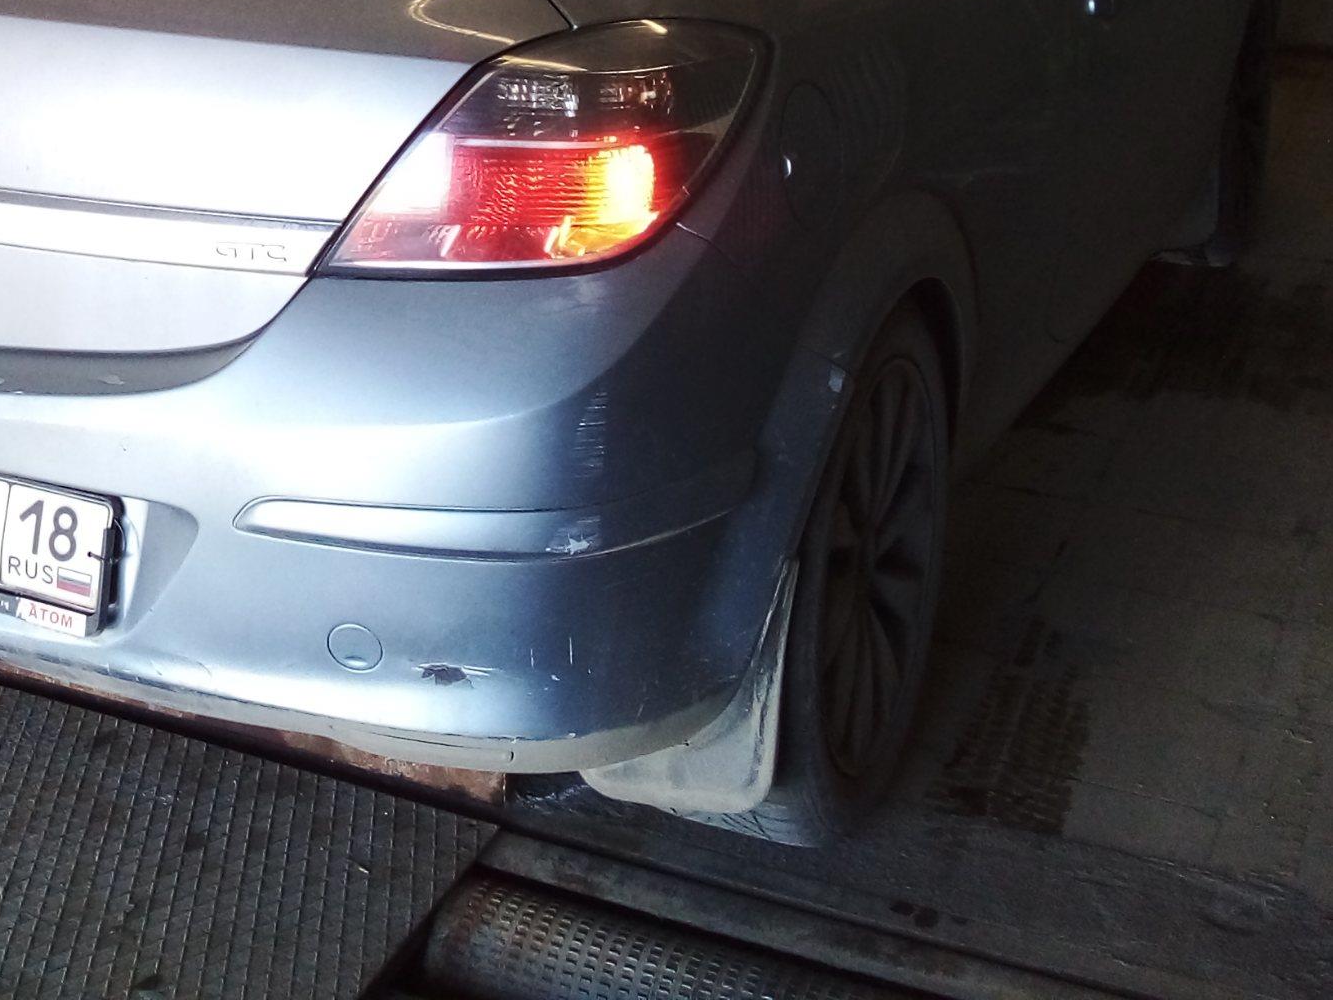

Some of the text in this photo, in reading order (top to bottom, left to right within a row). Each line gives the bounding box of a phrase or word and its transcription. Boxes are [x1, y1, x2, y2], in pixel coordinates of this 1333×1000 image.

[19, 499, 80, 562] 18
[8, 556, 55, 585] RUS
[28, 602, 74, 630] АТОМ
